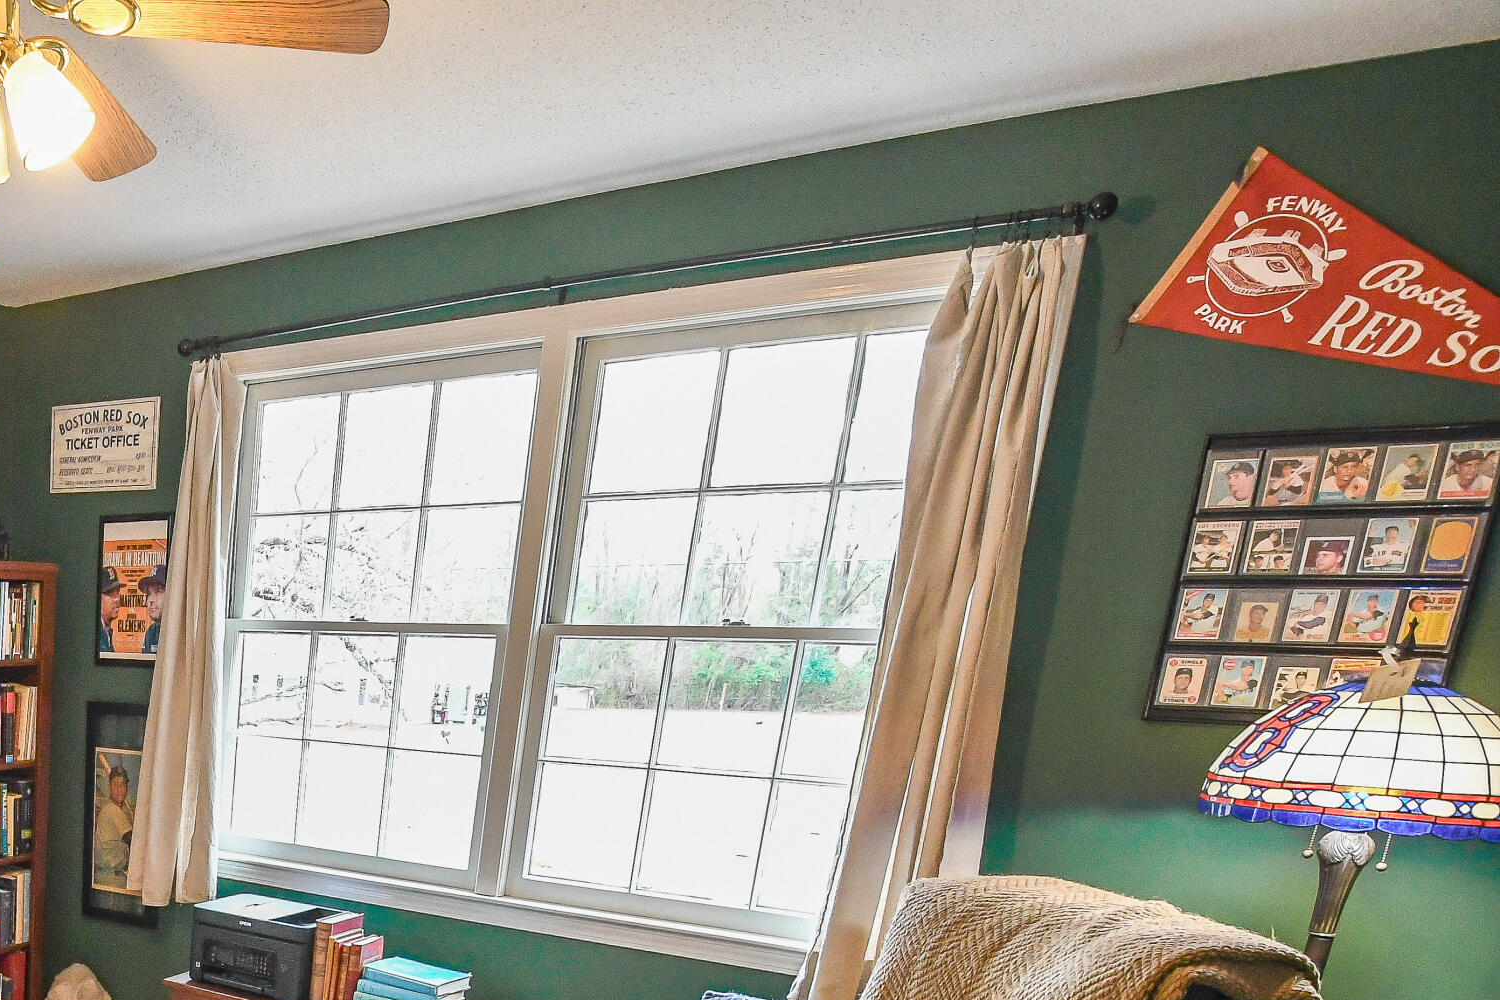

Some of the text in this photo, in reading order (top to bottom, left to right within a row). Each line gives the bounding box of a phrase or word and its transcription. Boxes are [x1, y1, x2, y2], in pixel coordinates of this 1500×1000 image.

[1266, 195, 1347, 234] FENWAY
[1358, 259, 1483, 329] Boston
[1193, 303, 1247, 335] PARK
[1308, 295, 1422, 358] RED
[59, 409, 148, 435] BOSTON RED SOX
[82, 425, 124, 435] FENWAY PARK
[66, 434, 140, 451] TICKET OFFICE
[103, 550, 167, 567] BRAWL IN BEANTOWN
[120, 594, 148, 607] MARTINEZ
[118, 619, 146, 633] CLEMENS
